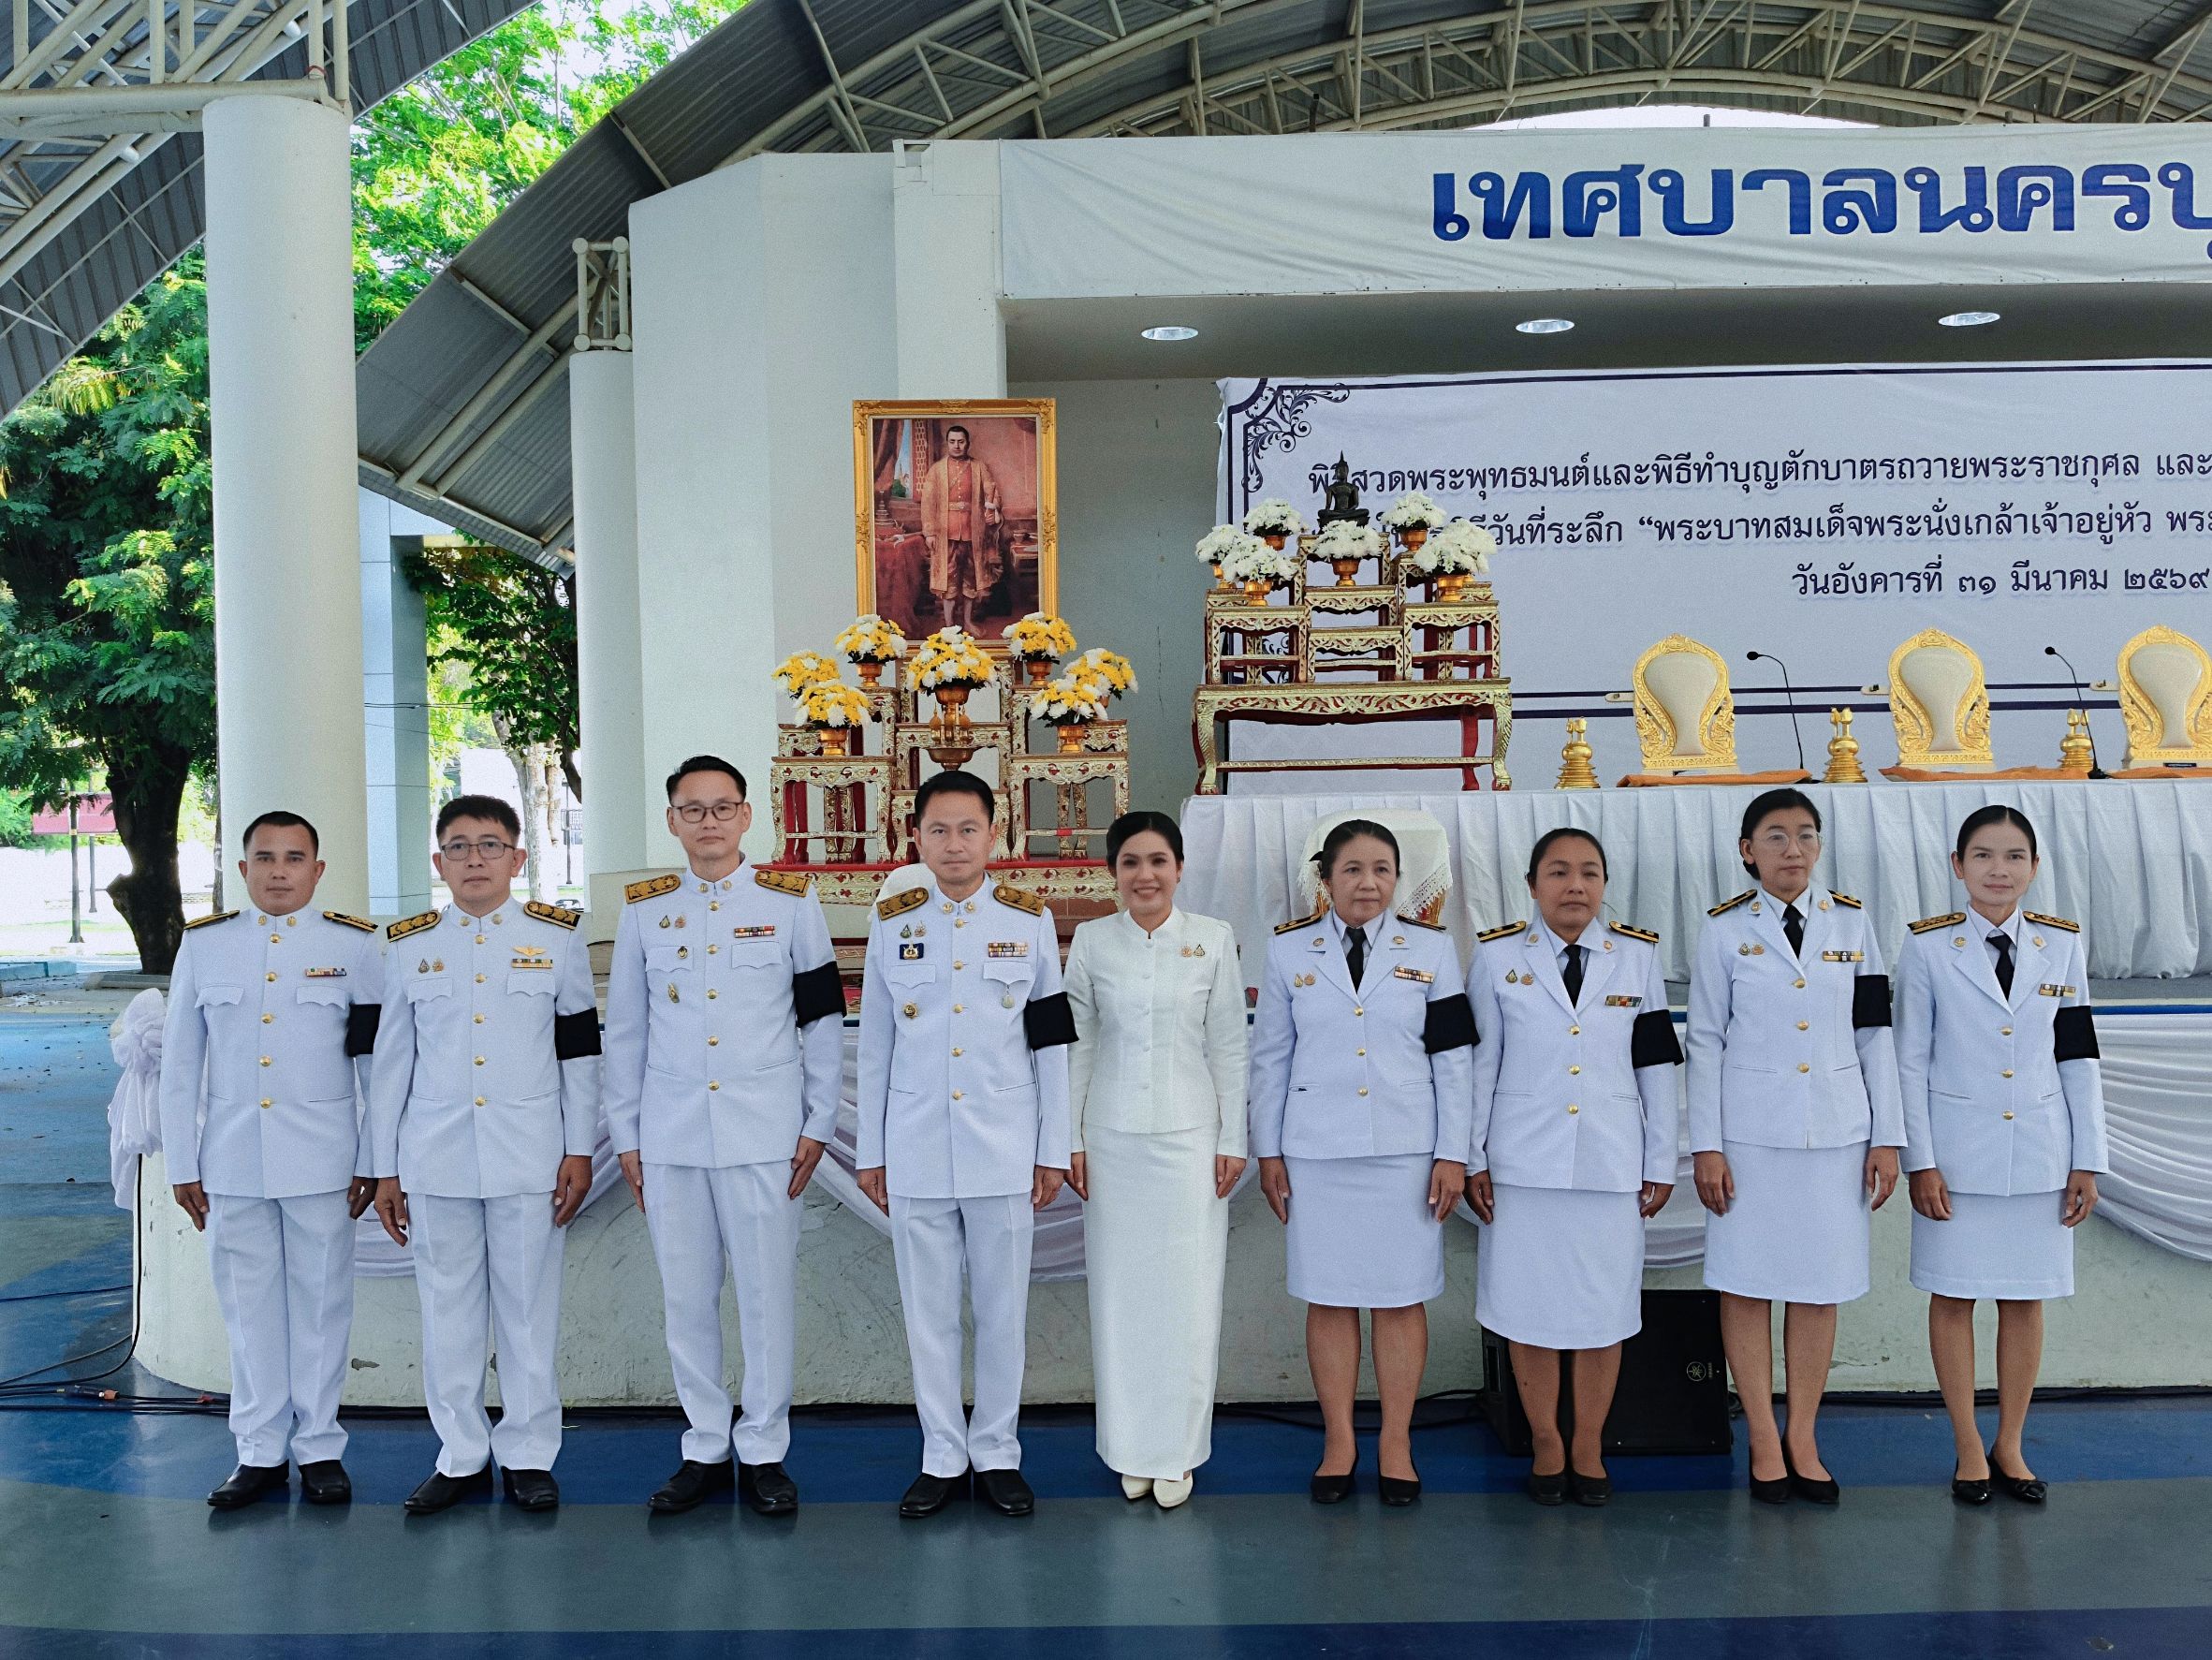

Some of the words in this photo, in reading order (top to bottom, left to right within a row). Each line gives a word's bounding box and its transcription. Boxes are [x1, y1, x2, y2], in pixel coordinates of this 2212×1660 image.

[1433, 162, 2212, 259] เทศบาลนครบ
[1309, 449, 2139, 500] พิสวดพระพุทธมนต์และพิธีทำบุญตักบาตรถวายพระราชกุศล
[2157, 453, 2212, 476] และ
[1639, 498, 2151, 545] “พระบาทสมเด็จพระนั่งเกล้าเจ้าอยู่หัว
[2166, 510, 2212, 532] พร
[1792, 554, 1942, 595] วันอังคารที่
[1958, 575, 1997, 595] ๓๑
[2011, 559, 2108, 592] มีนาคม
[2124, 567, 2210, 590] ๒๕๖๙
